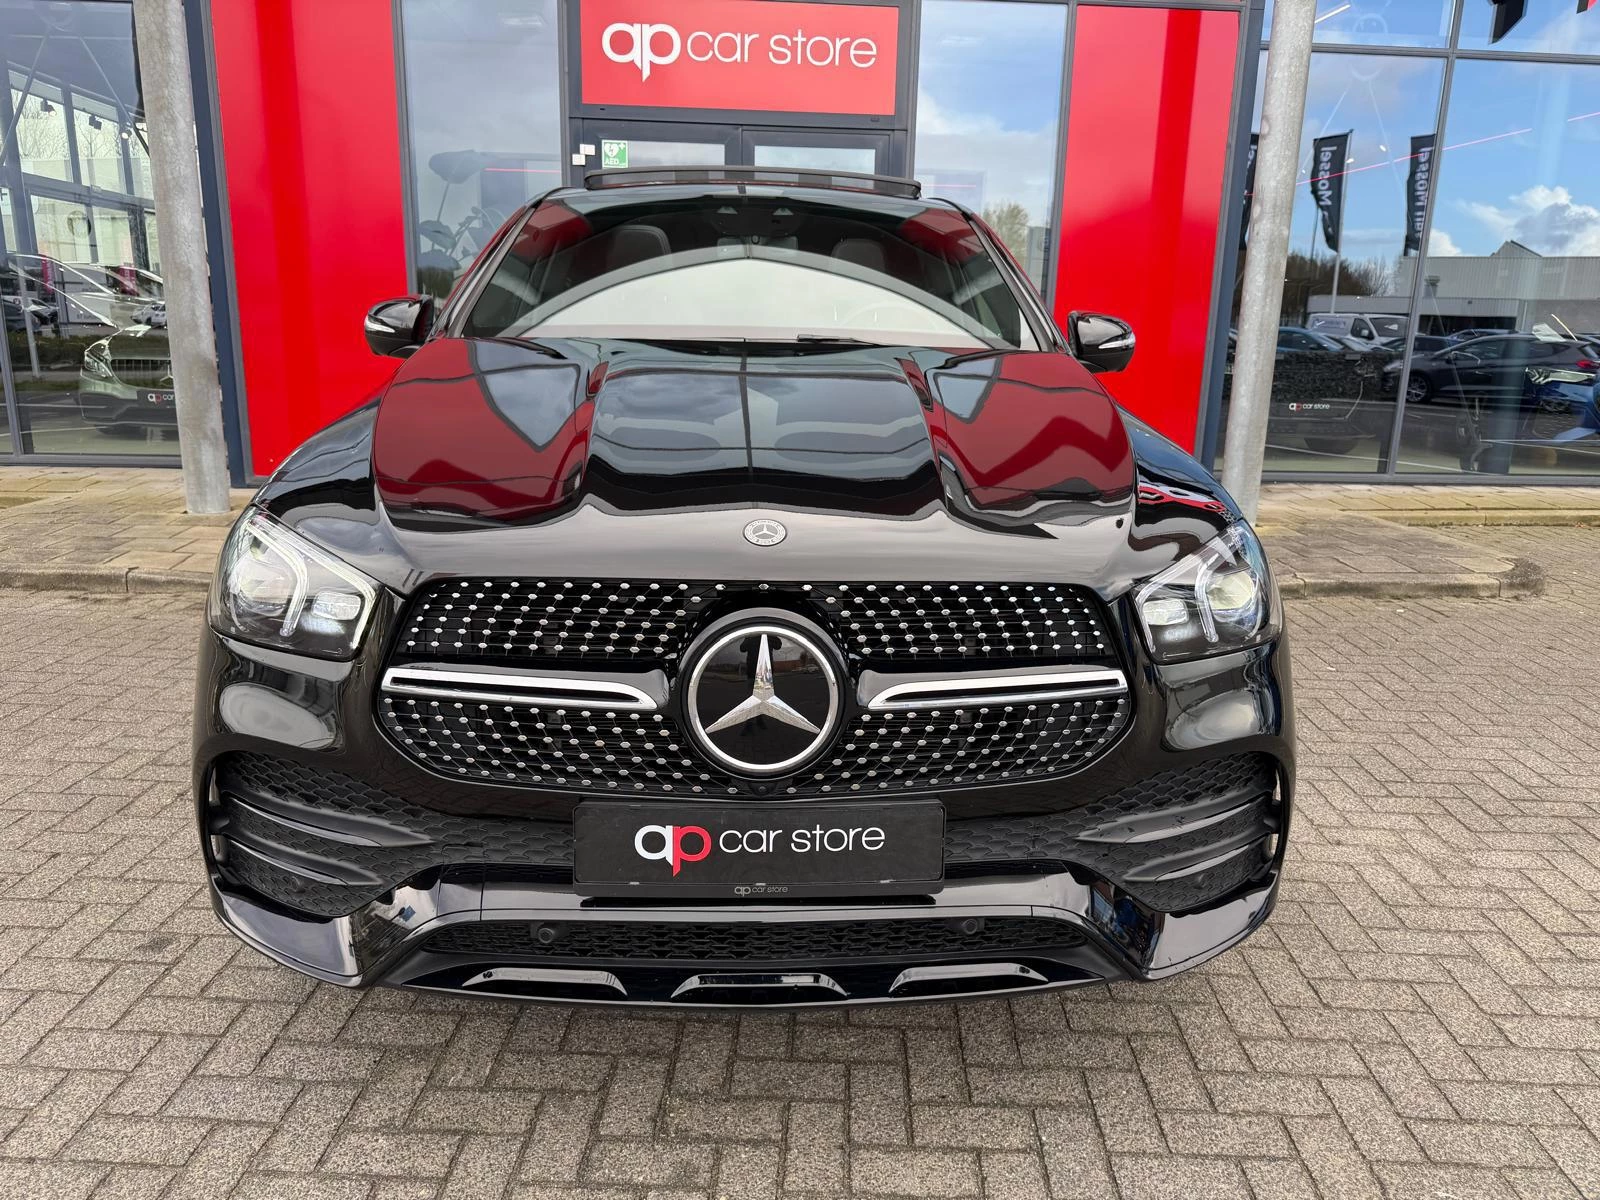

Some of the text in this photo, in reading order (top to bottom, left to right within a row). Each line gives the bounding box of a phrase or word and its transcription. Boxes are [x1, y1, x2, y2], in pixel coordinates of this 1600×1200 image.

[687, 31, 759, 62] car
[768, 29, 877, 68] store
[604, 157, 620, 165] AED
[719, 829, 783, 853] car
[791, 824, 886, 852] store
[767, 885, 788, 893] store
